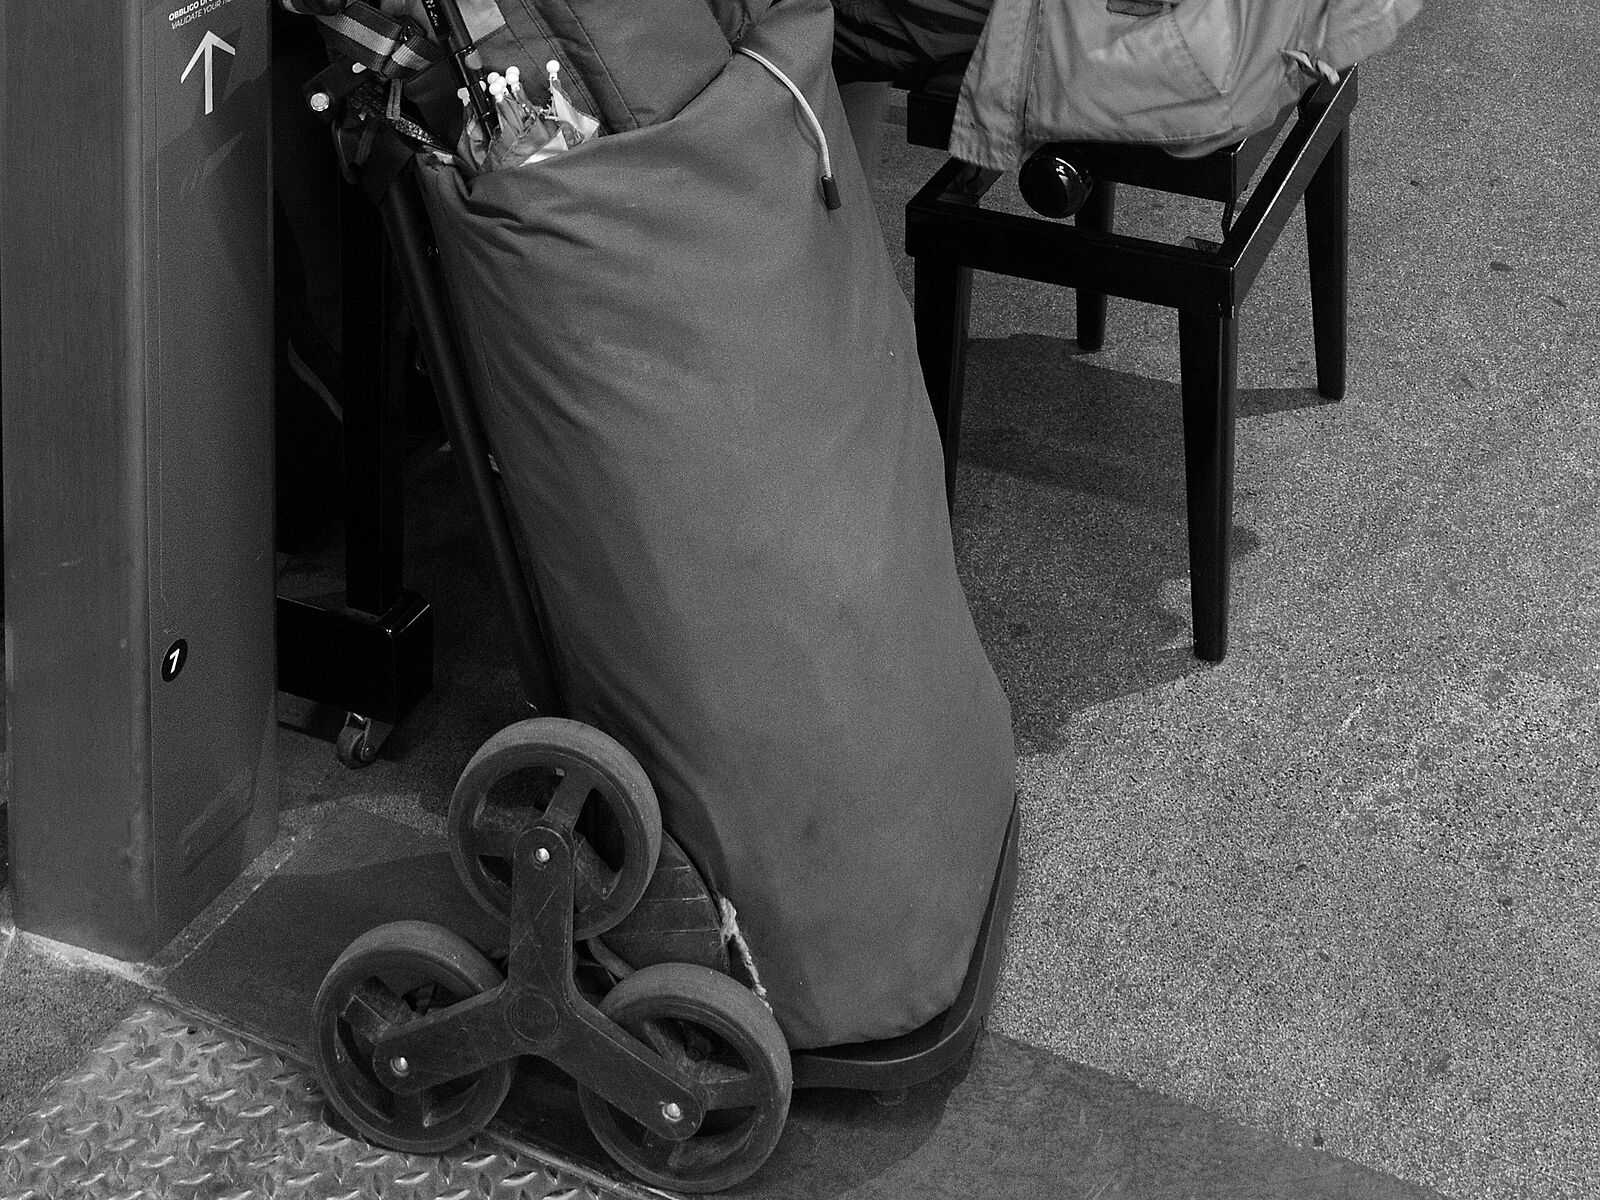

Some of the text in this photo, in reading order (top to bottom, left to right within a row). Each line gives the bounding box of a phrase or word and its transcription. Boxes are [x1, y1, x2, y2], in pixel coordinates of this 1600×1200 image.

[168, 1, 199, 21] OBBLIGO
[171, 9, 203, 30] VALIDATE
[203, 0, 222, 14] YOUR
